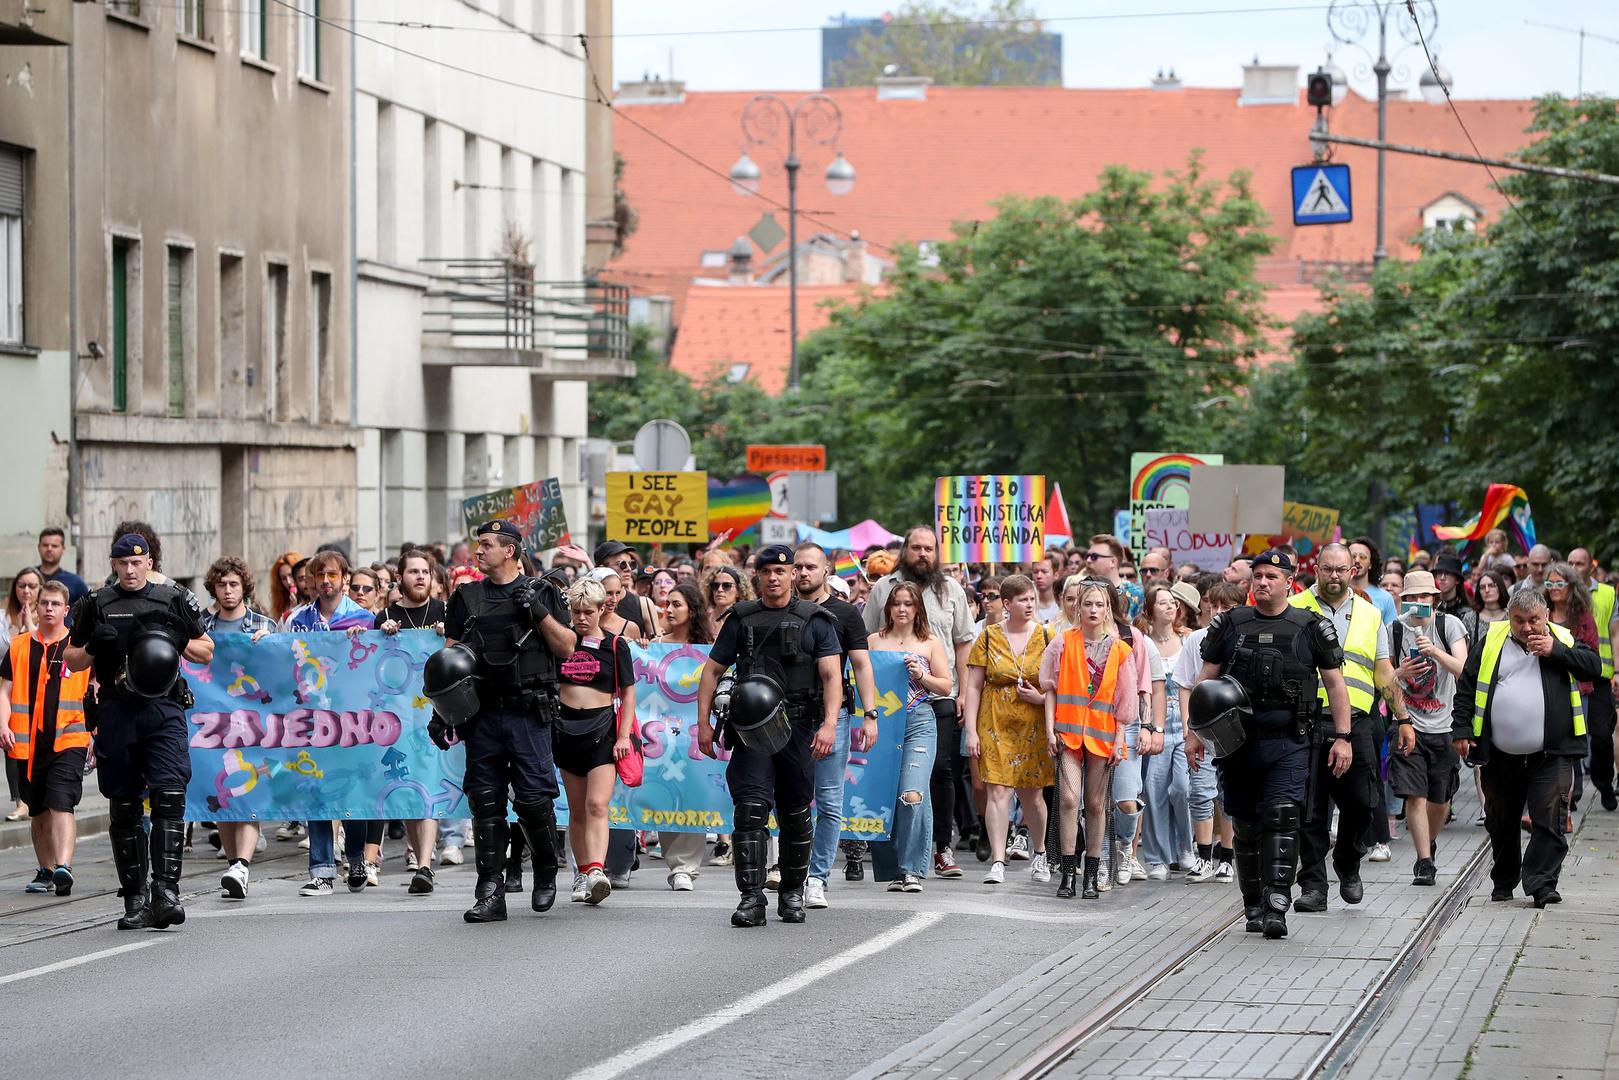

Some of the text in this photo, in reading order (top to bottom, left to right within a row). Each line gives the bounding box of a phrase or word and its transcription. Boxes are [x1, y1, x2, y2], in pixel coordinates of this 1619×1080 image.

[629, 475, 678, 491] I SEE
[952, 480, 1019, 499] LEZBO
[623, 493, 684, 517] GAY
[936, 500, 1045, 523] FEMINISTIČKA
[625, 518, 697, 537] PEOPLE
[941, 525, 1042, 546] PROPAGANDA
[190, 708, 402, 749] ZAJEDNO
[641, 809, 724, 827] POVORKA
